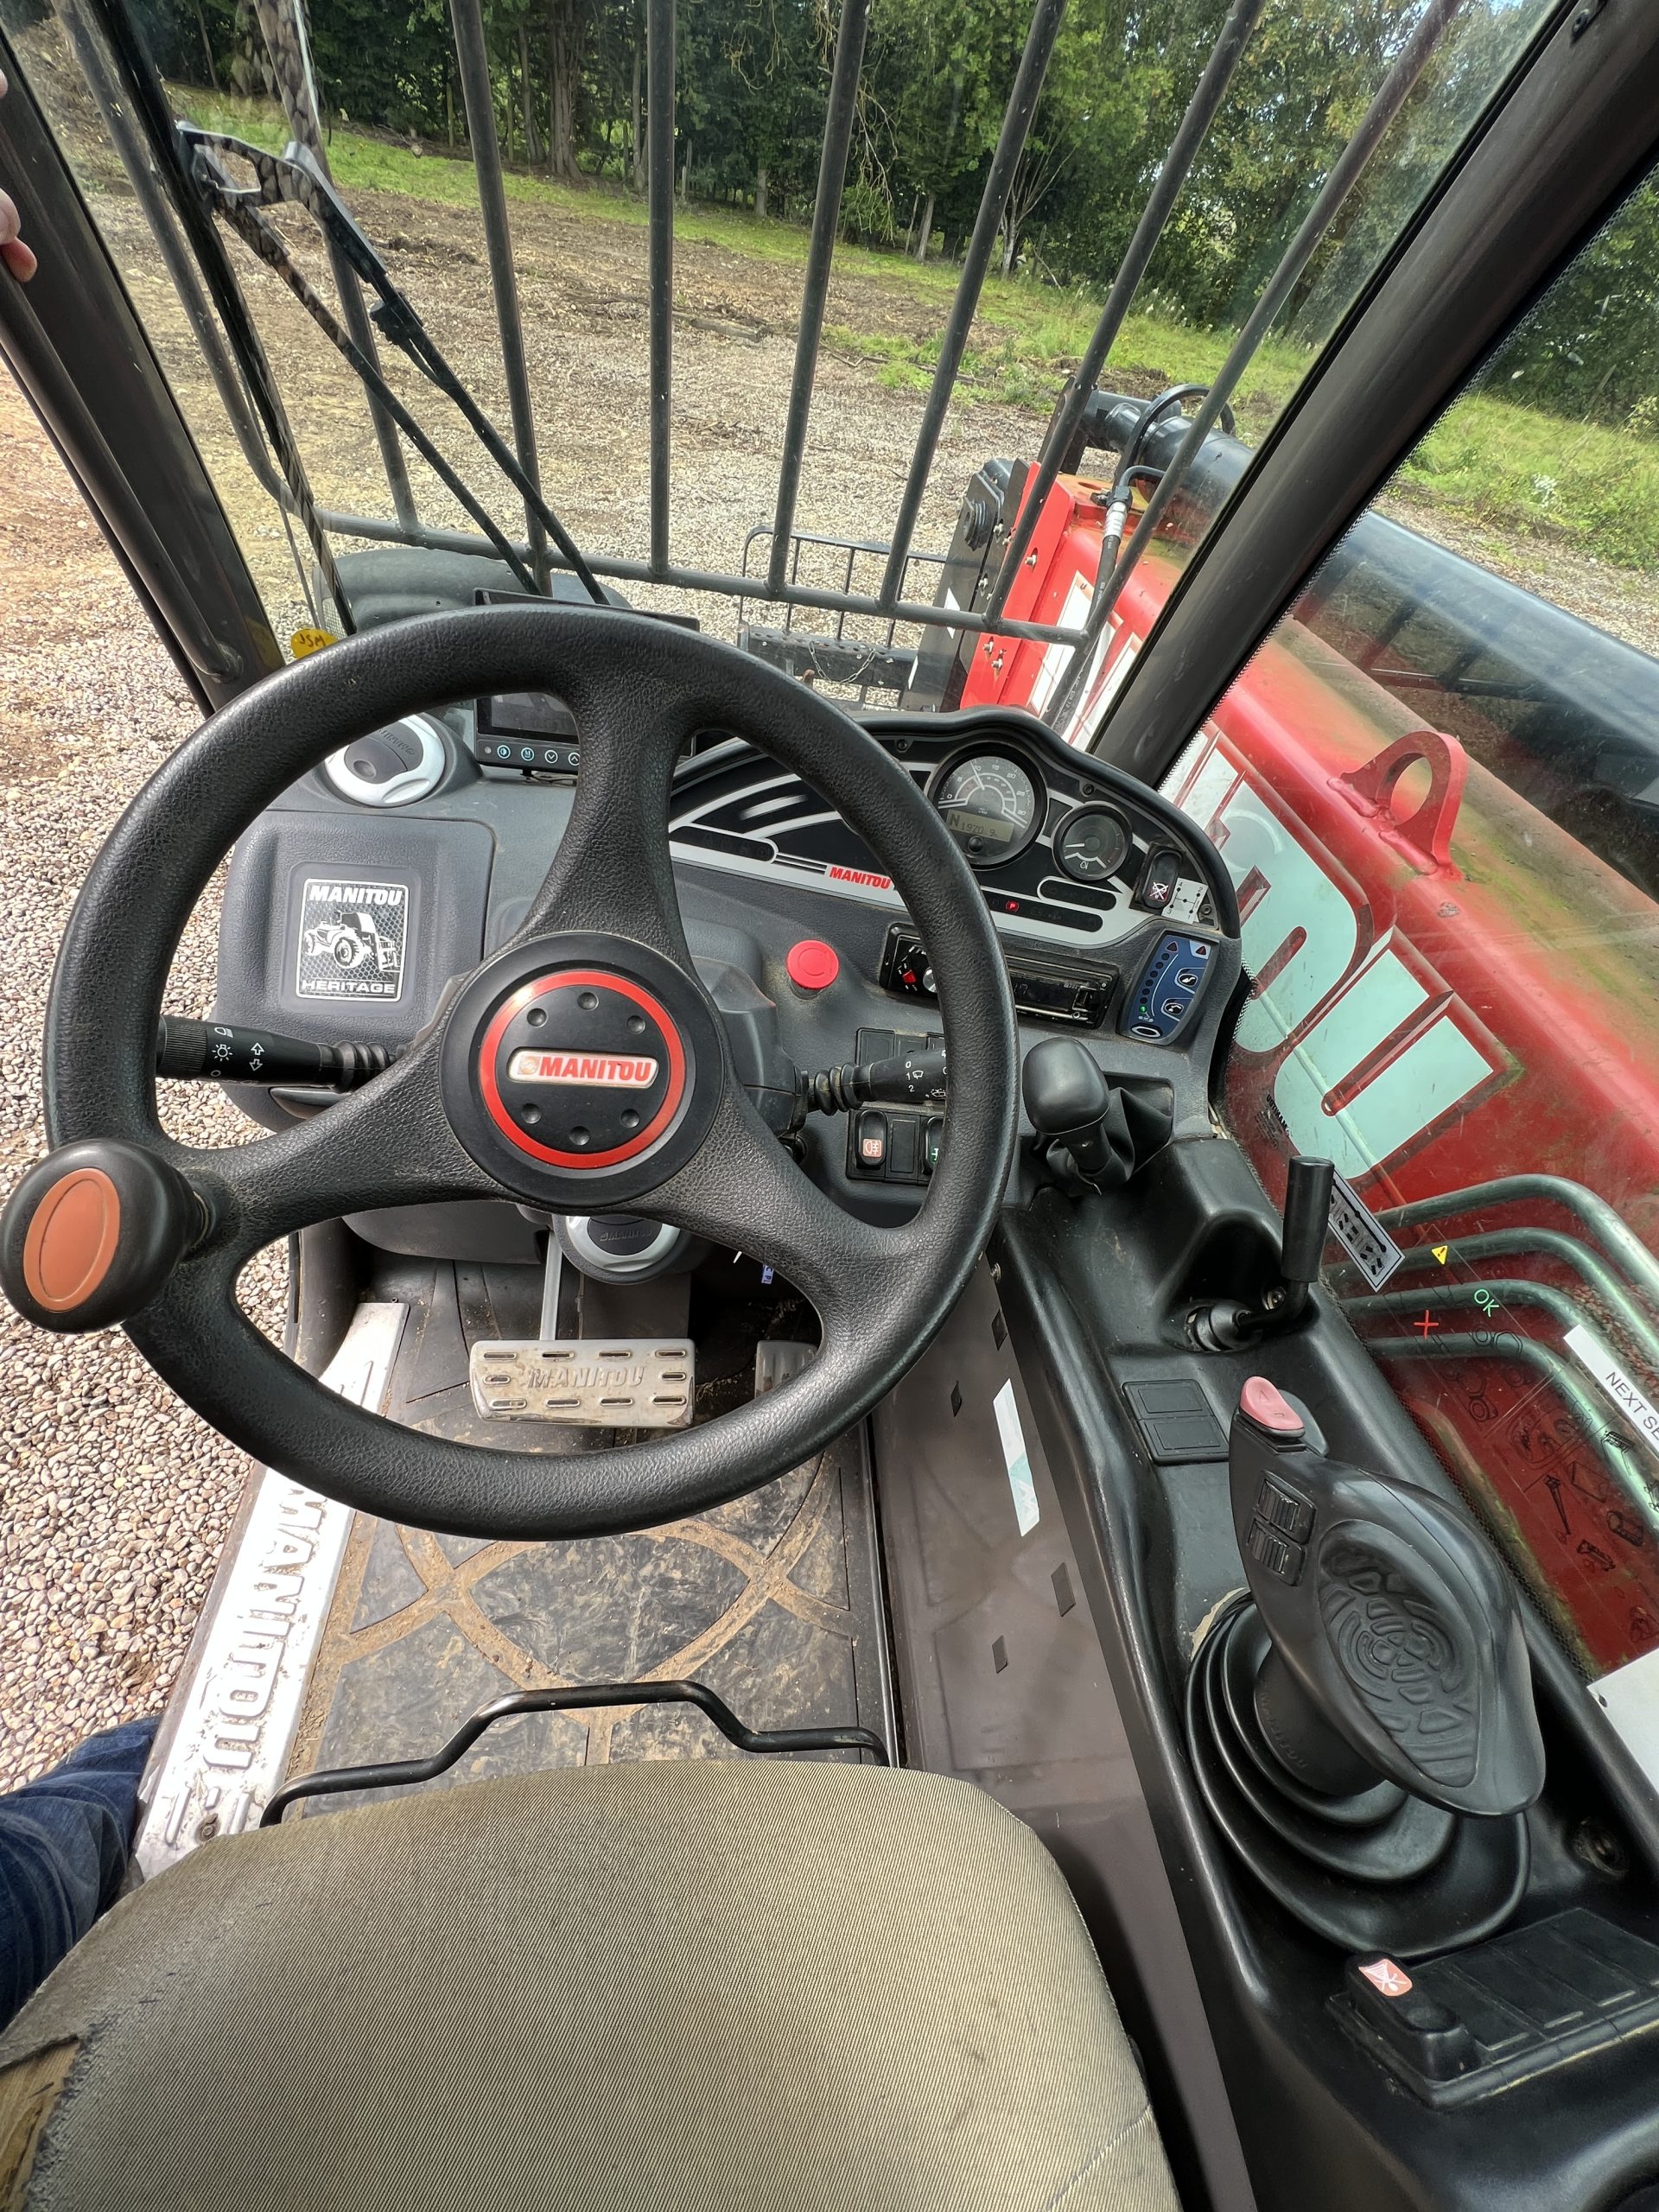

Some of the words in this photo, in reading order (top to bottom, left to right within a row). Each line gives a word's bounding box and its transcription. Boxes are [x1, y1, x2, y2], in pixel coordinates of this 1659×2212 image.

[950, 814, 961, 827] N
[830, 867, 892, 889] MANITOU
[309, 885, 403, 906] MANITOU
[302, 979, 396, 994] HERITAGE
[539, 1056, 652, 1082] MANITOU
[906, 1071, 911, 1081] 1
[908, 1084, 916, 1093] 2
[1473, 1288, 1500, 1318] OK
[528, 1366, 645, 1389] MANITOU
[1605, 1371, 1647, 1414] NEXT
